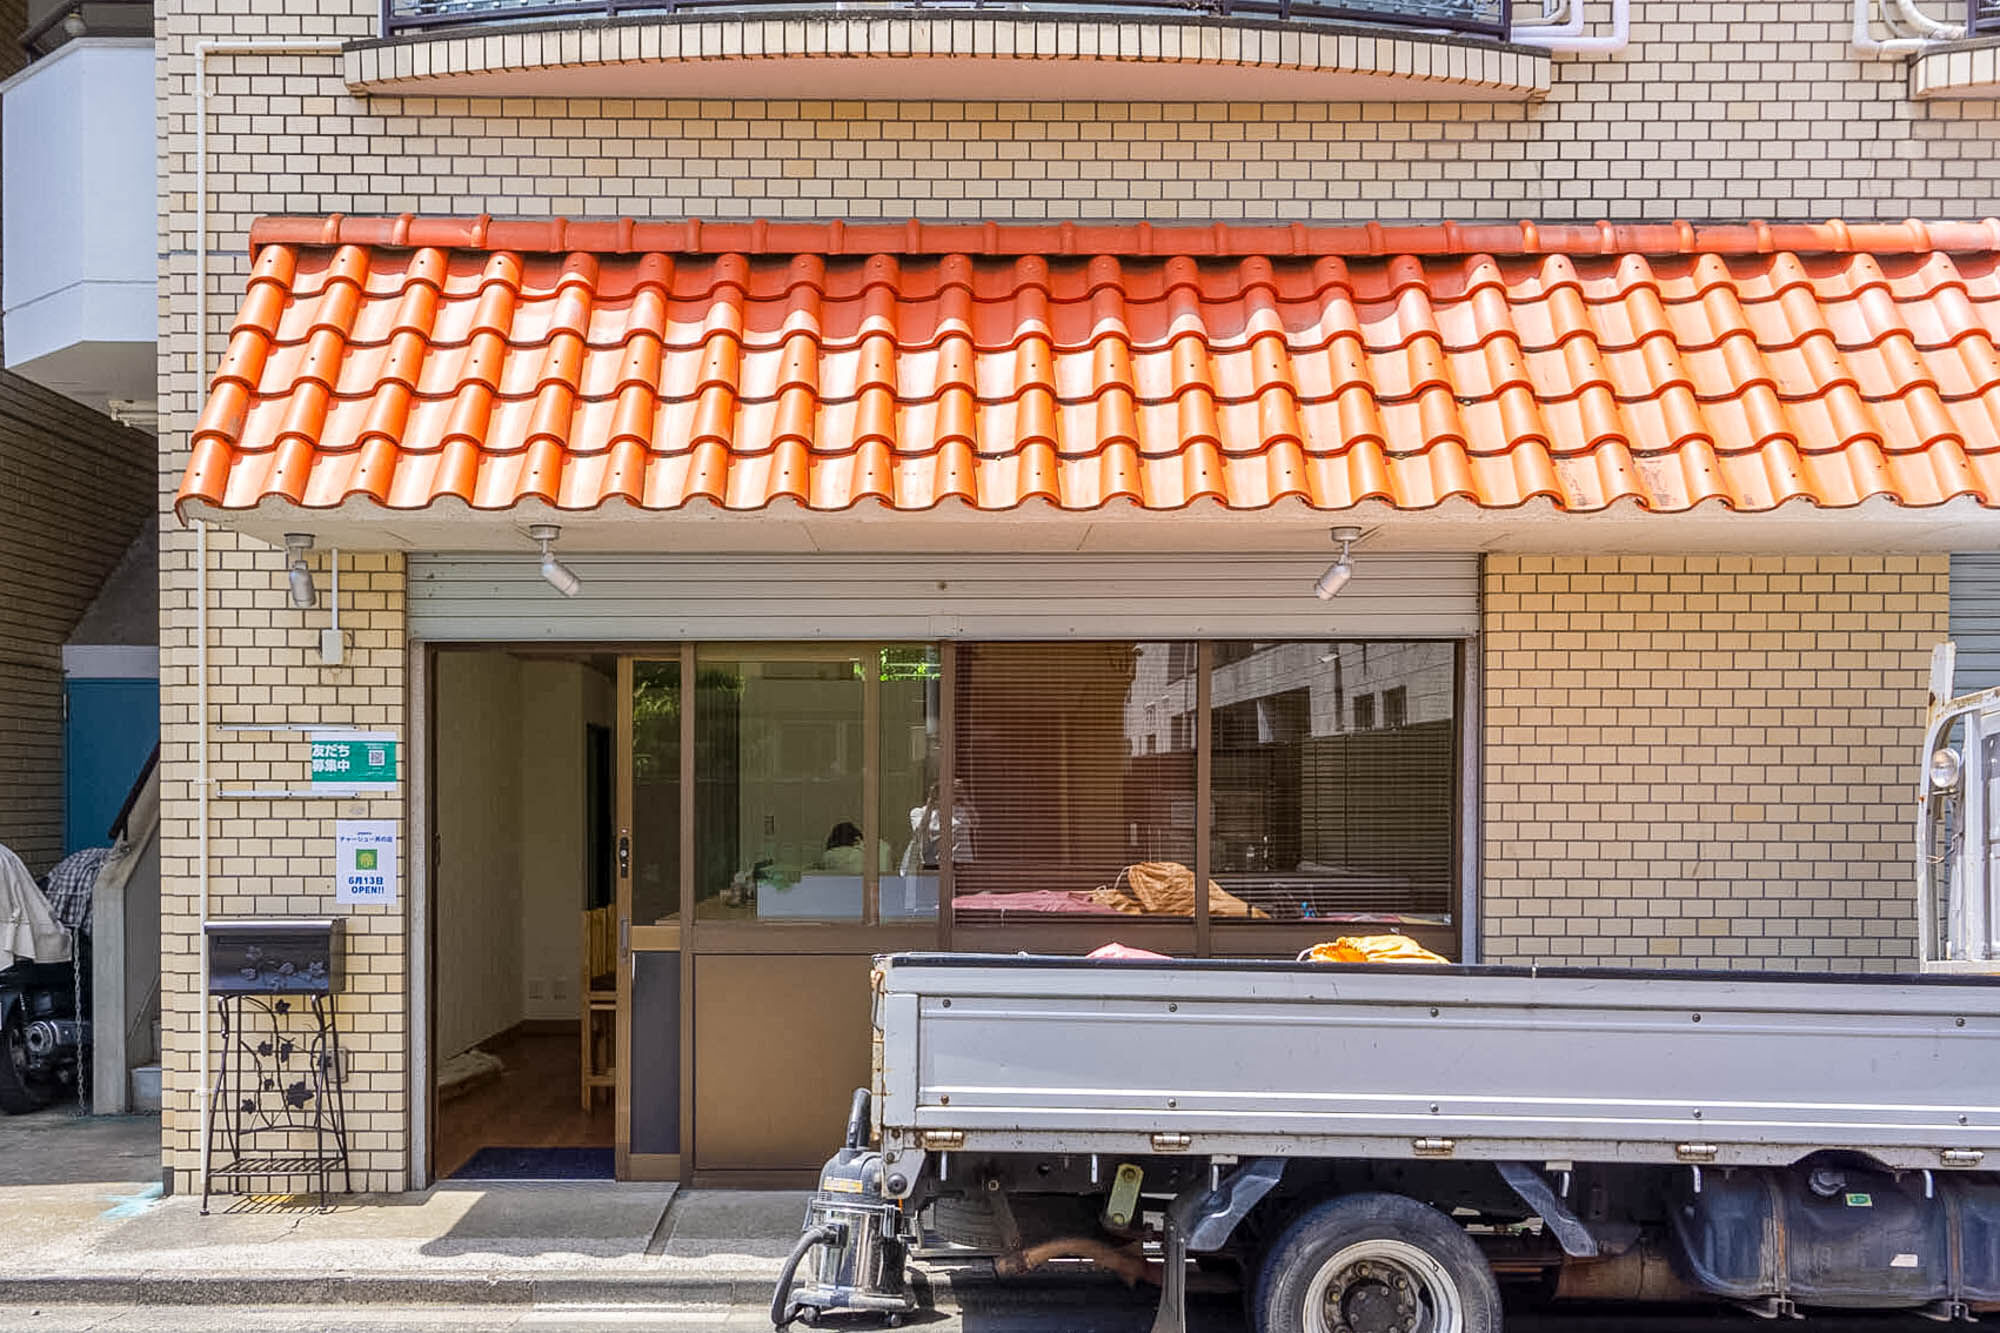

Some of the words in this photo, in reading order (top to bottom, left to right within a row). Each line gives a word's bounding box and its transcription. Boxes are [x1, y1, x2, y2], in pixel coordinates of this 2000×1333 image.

[312, 744, 350, 757] 友だち
[348, 876, 384, 885] 6月13日
[351, 886, 385, 894] OPEN!!
